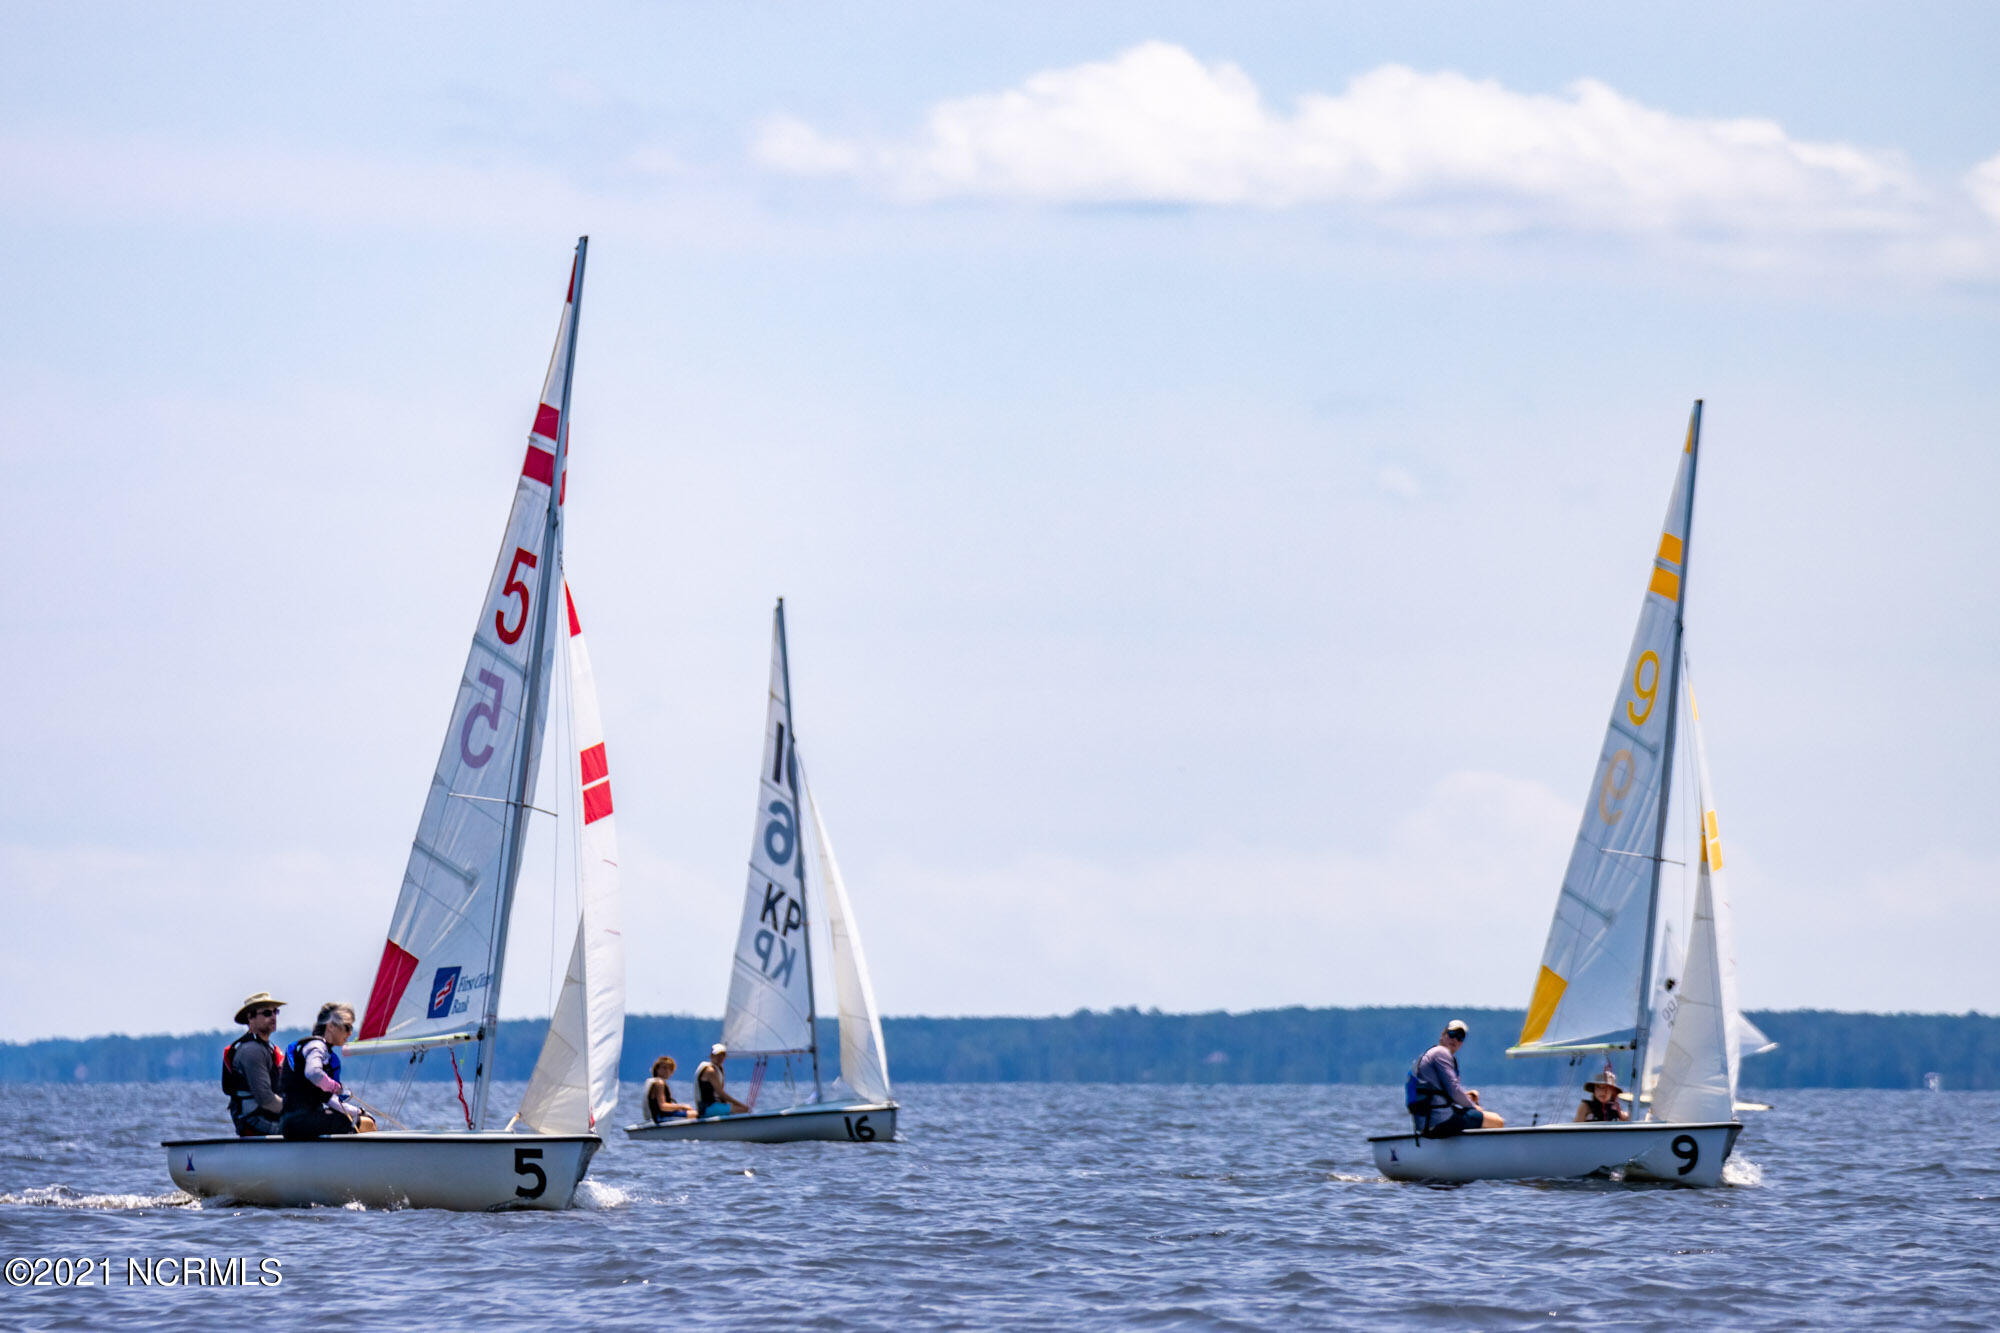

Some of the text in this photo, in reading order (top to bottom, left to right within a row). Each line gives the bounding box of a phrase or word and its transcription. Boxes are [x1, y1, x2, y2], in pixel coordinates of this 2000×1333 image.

[495, 547, 538, 645] 5
[1627, 650, 1660, 726] 9
[760, 883, 801, 936] KP
[844, 1115, 876, 1142] 16
[514, 1148, 548, 1198] 5
[1671, 1135, 1699, 1176] 9
